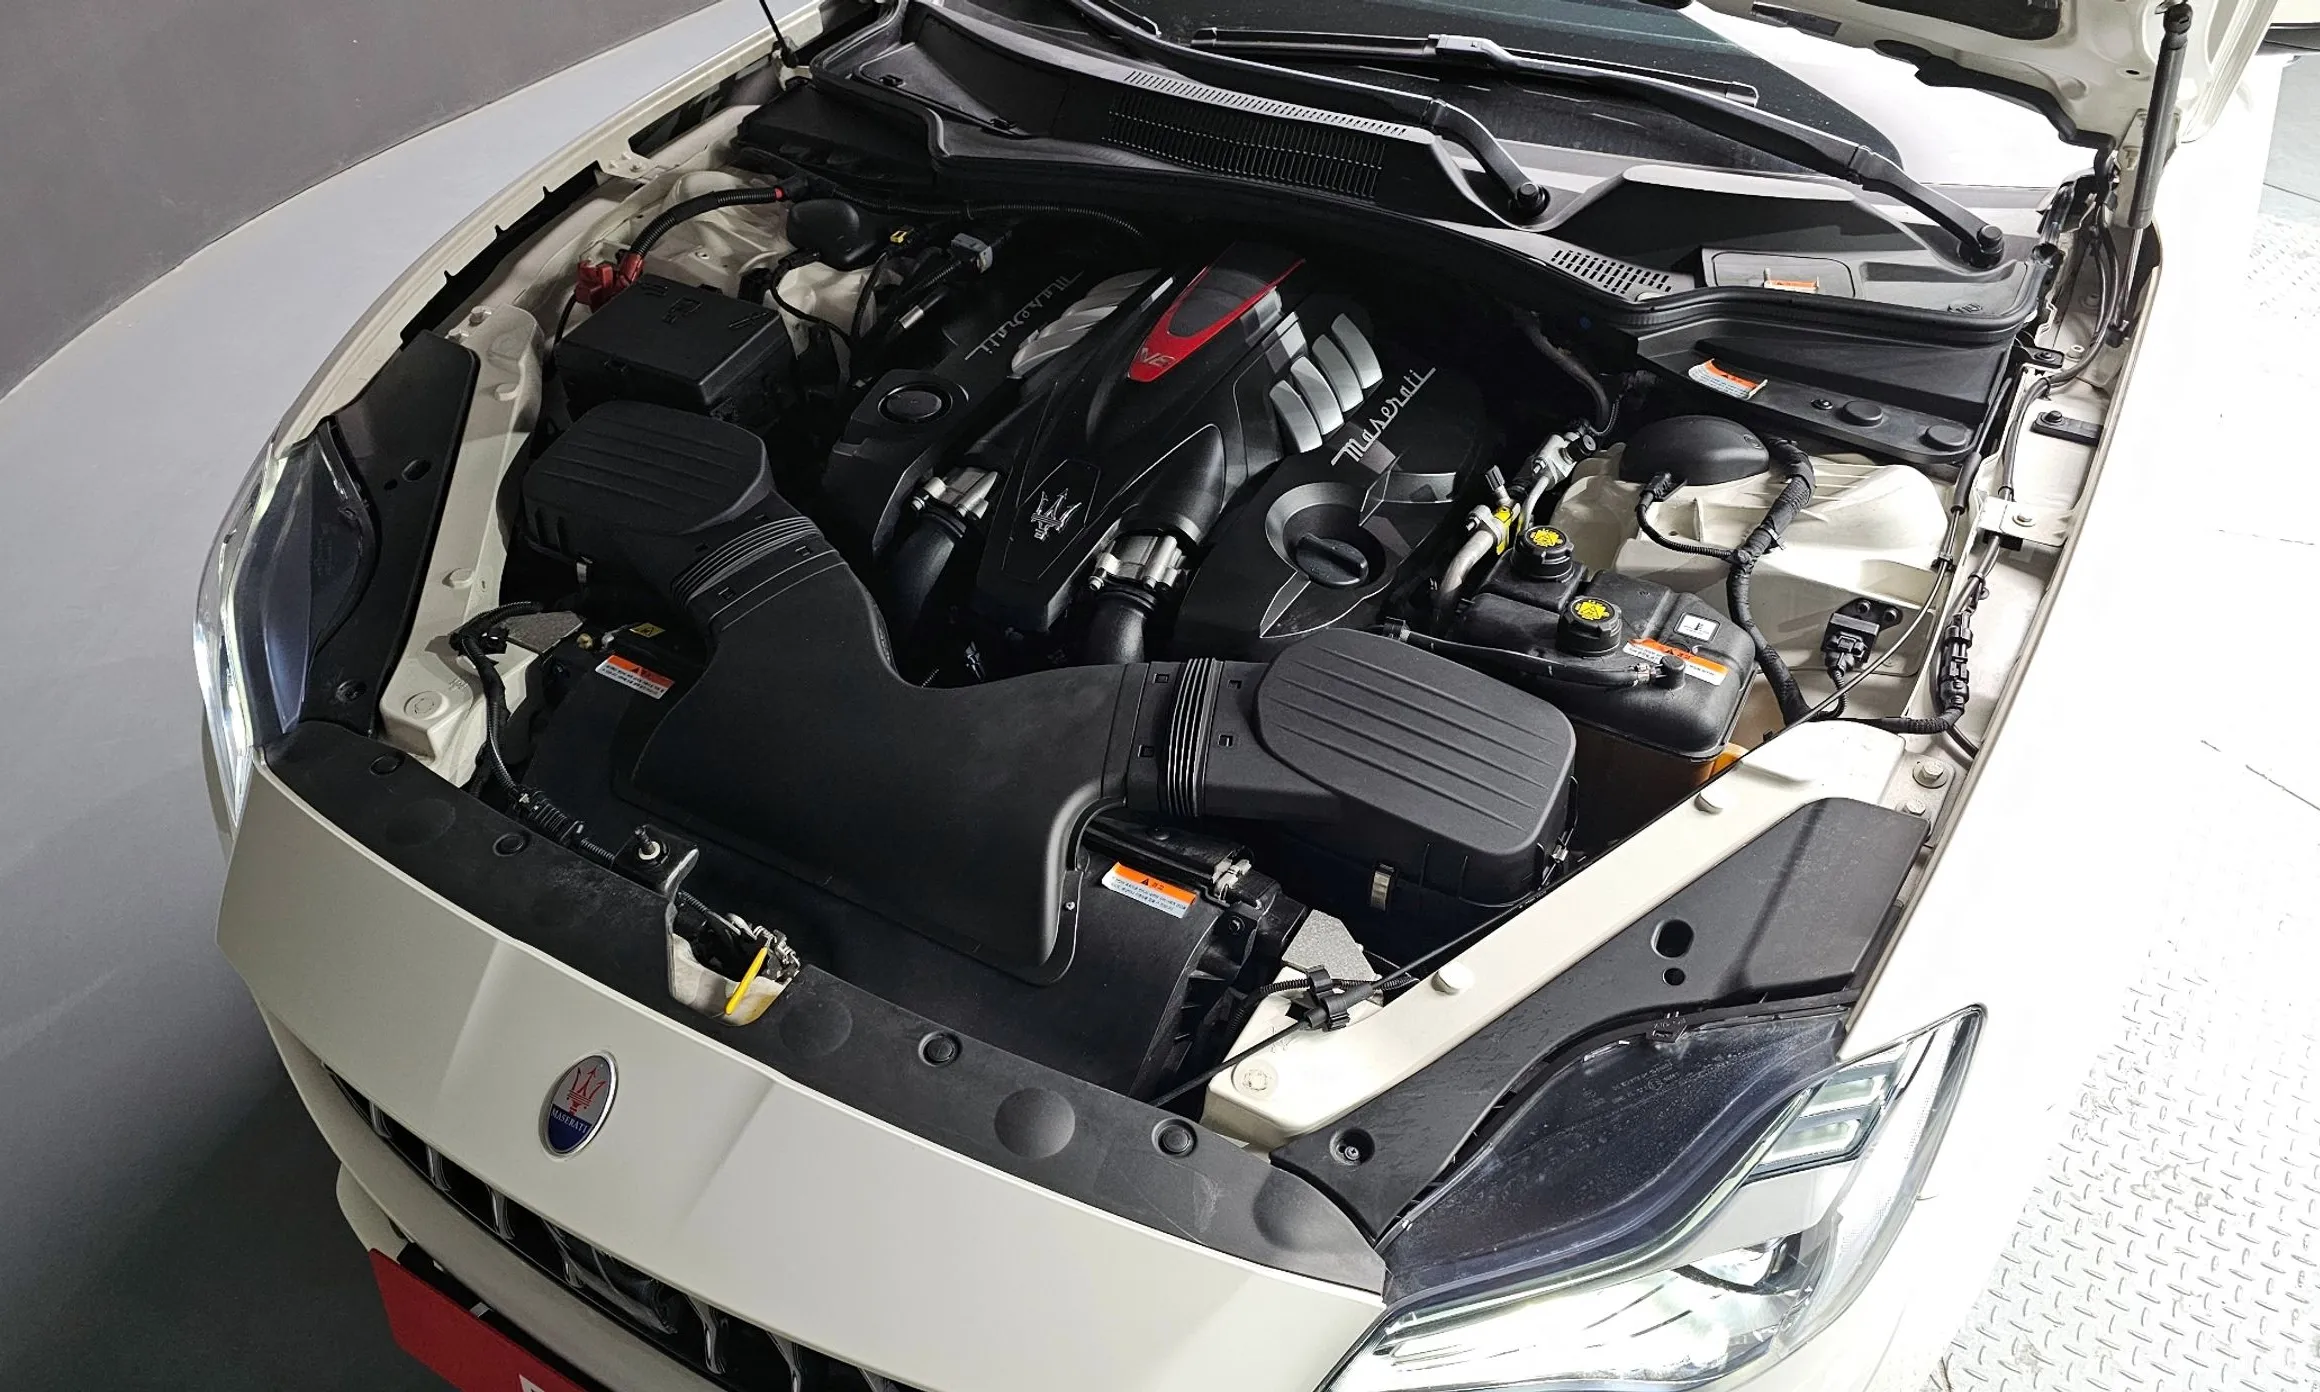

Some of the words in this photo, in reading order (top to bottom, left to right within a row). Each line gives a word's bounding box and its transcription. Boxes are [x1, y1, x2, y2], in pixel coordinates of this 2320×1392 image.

[964, 270, 1084, 361] Maserati
[1330, 366, 1437, 467] Maserati
[550, 1108, 588, 1133] MASERATI
